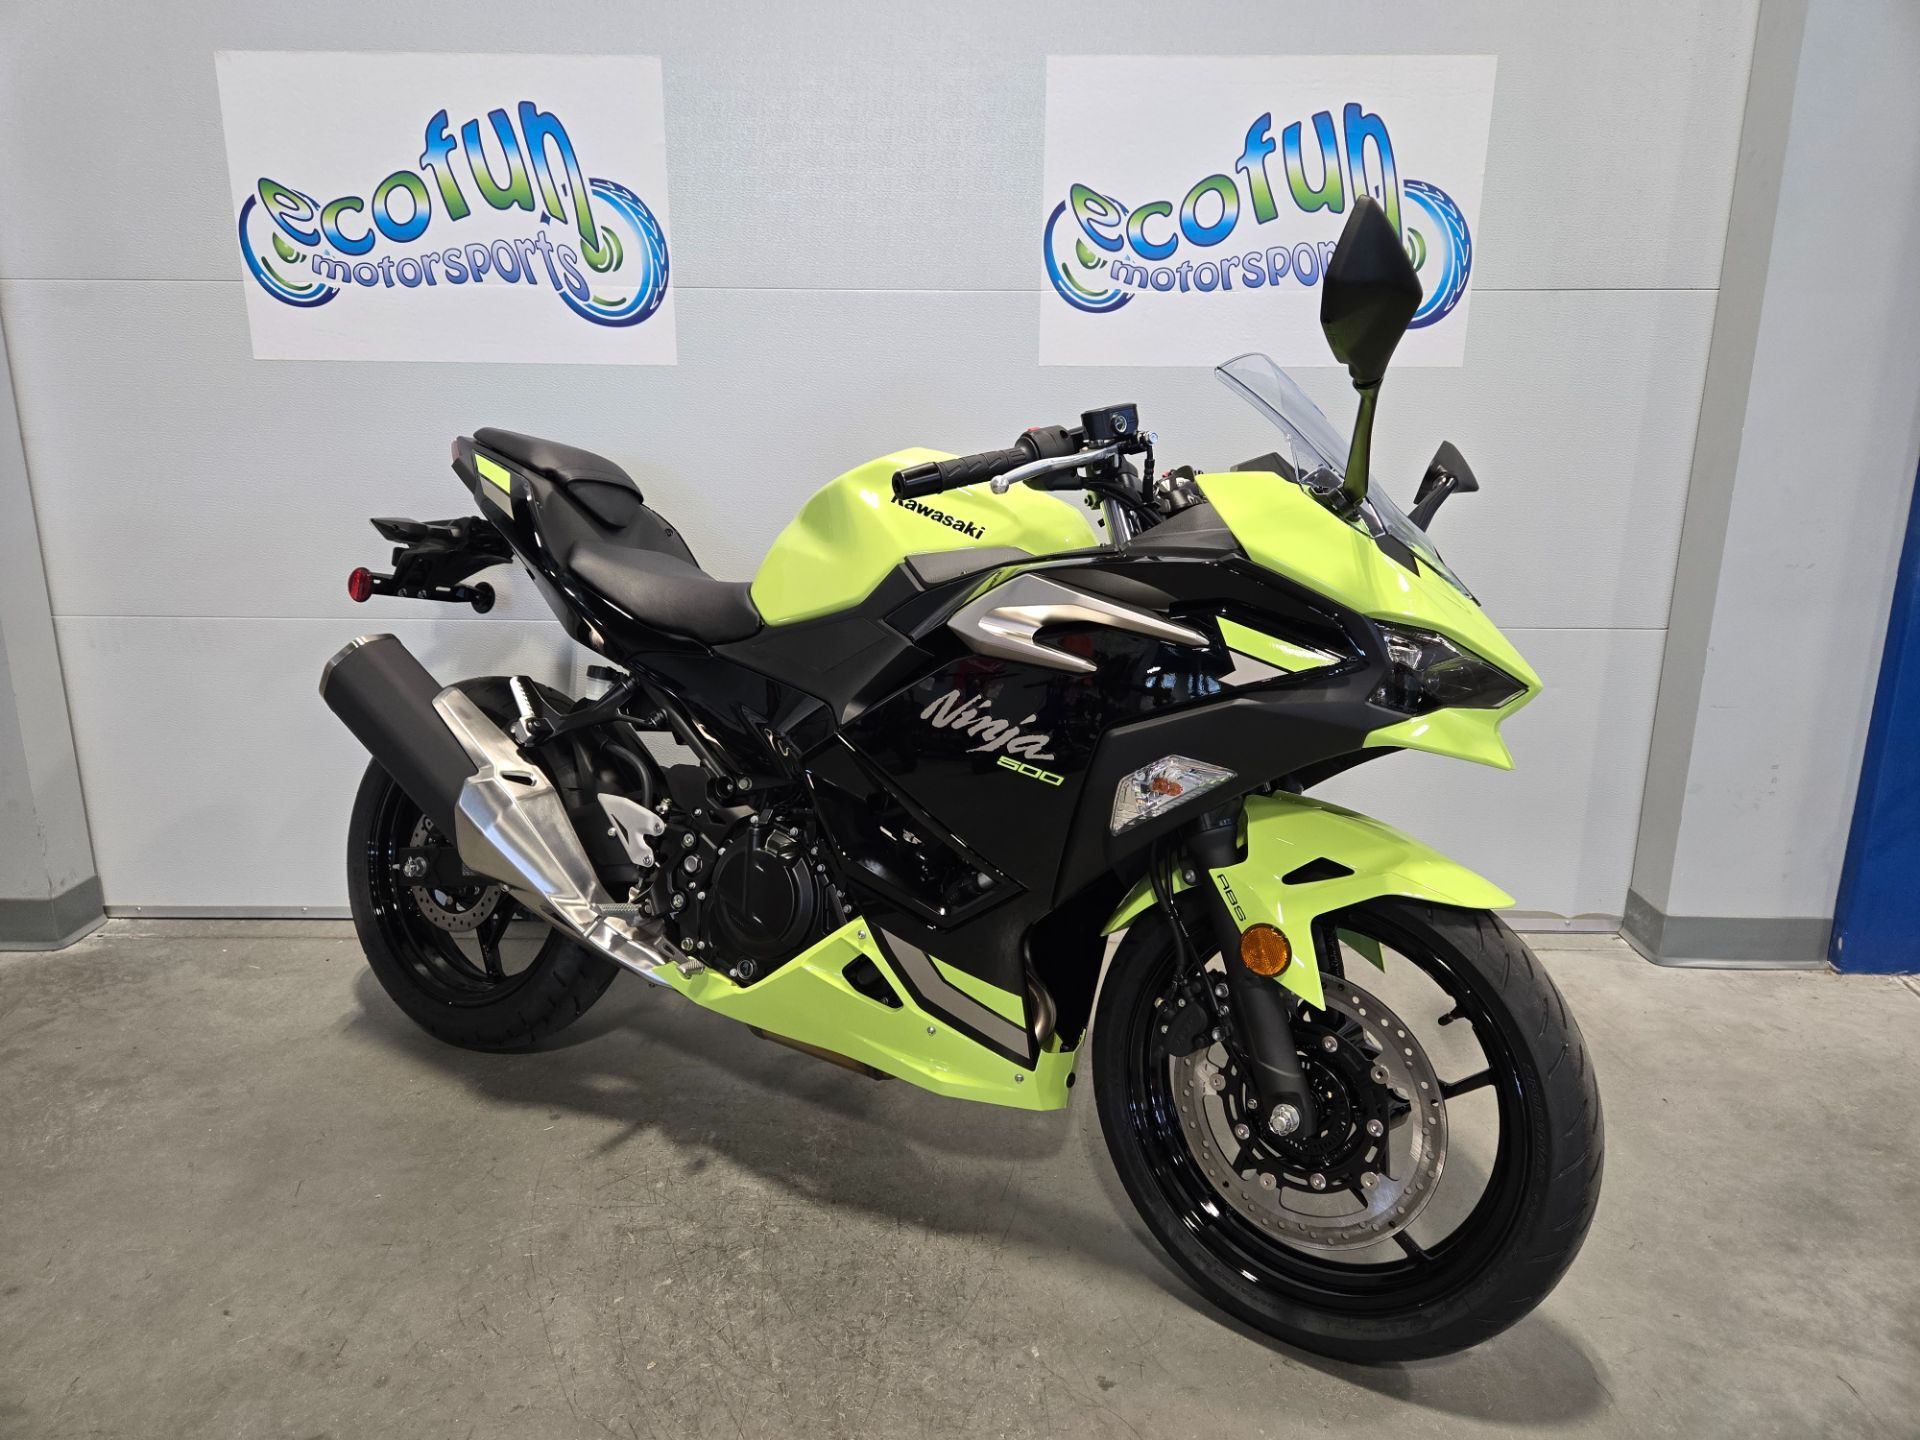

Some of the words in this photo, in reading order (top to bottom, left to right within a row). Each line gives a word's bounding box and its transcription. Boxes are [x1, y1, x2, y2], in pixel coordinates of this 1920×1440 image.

[258, 100, 600, 255] ecofun
[311, 230, 590, 301] motorsports
[1110, 241, 1337, 292] motorspor
[920, 689, 1055, 761] Ninja
[996, 756, 1065, 786] 500
[1217, 873, 1247, 921] ABS
